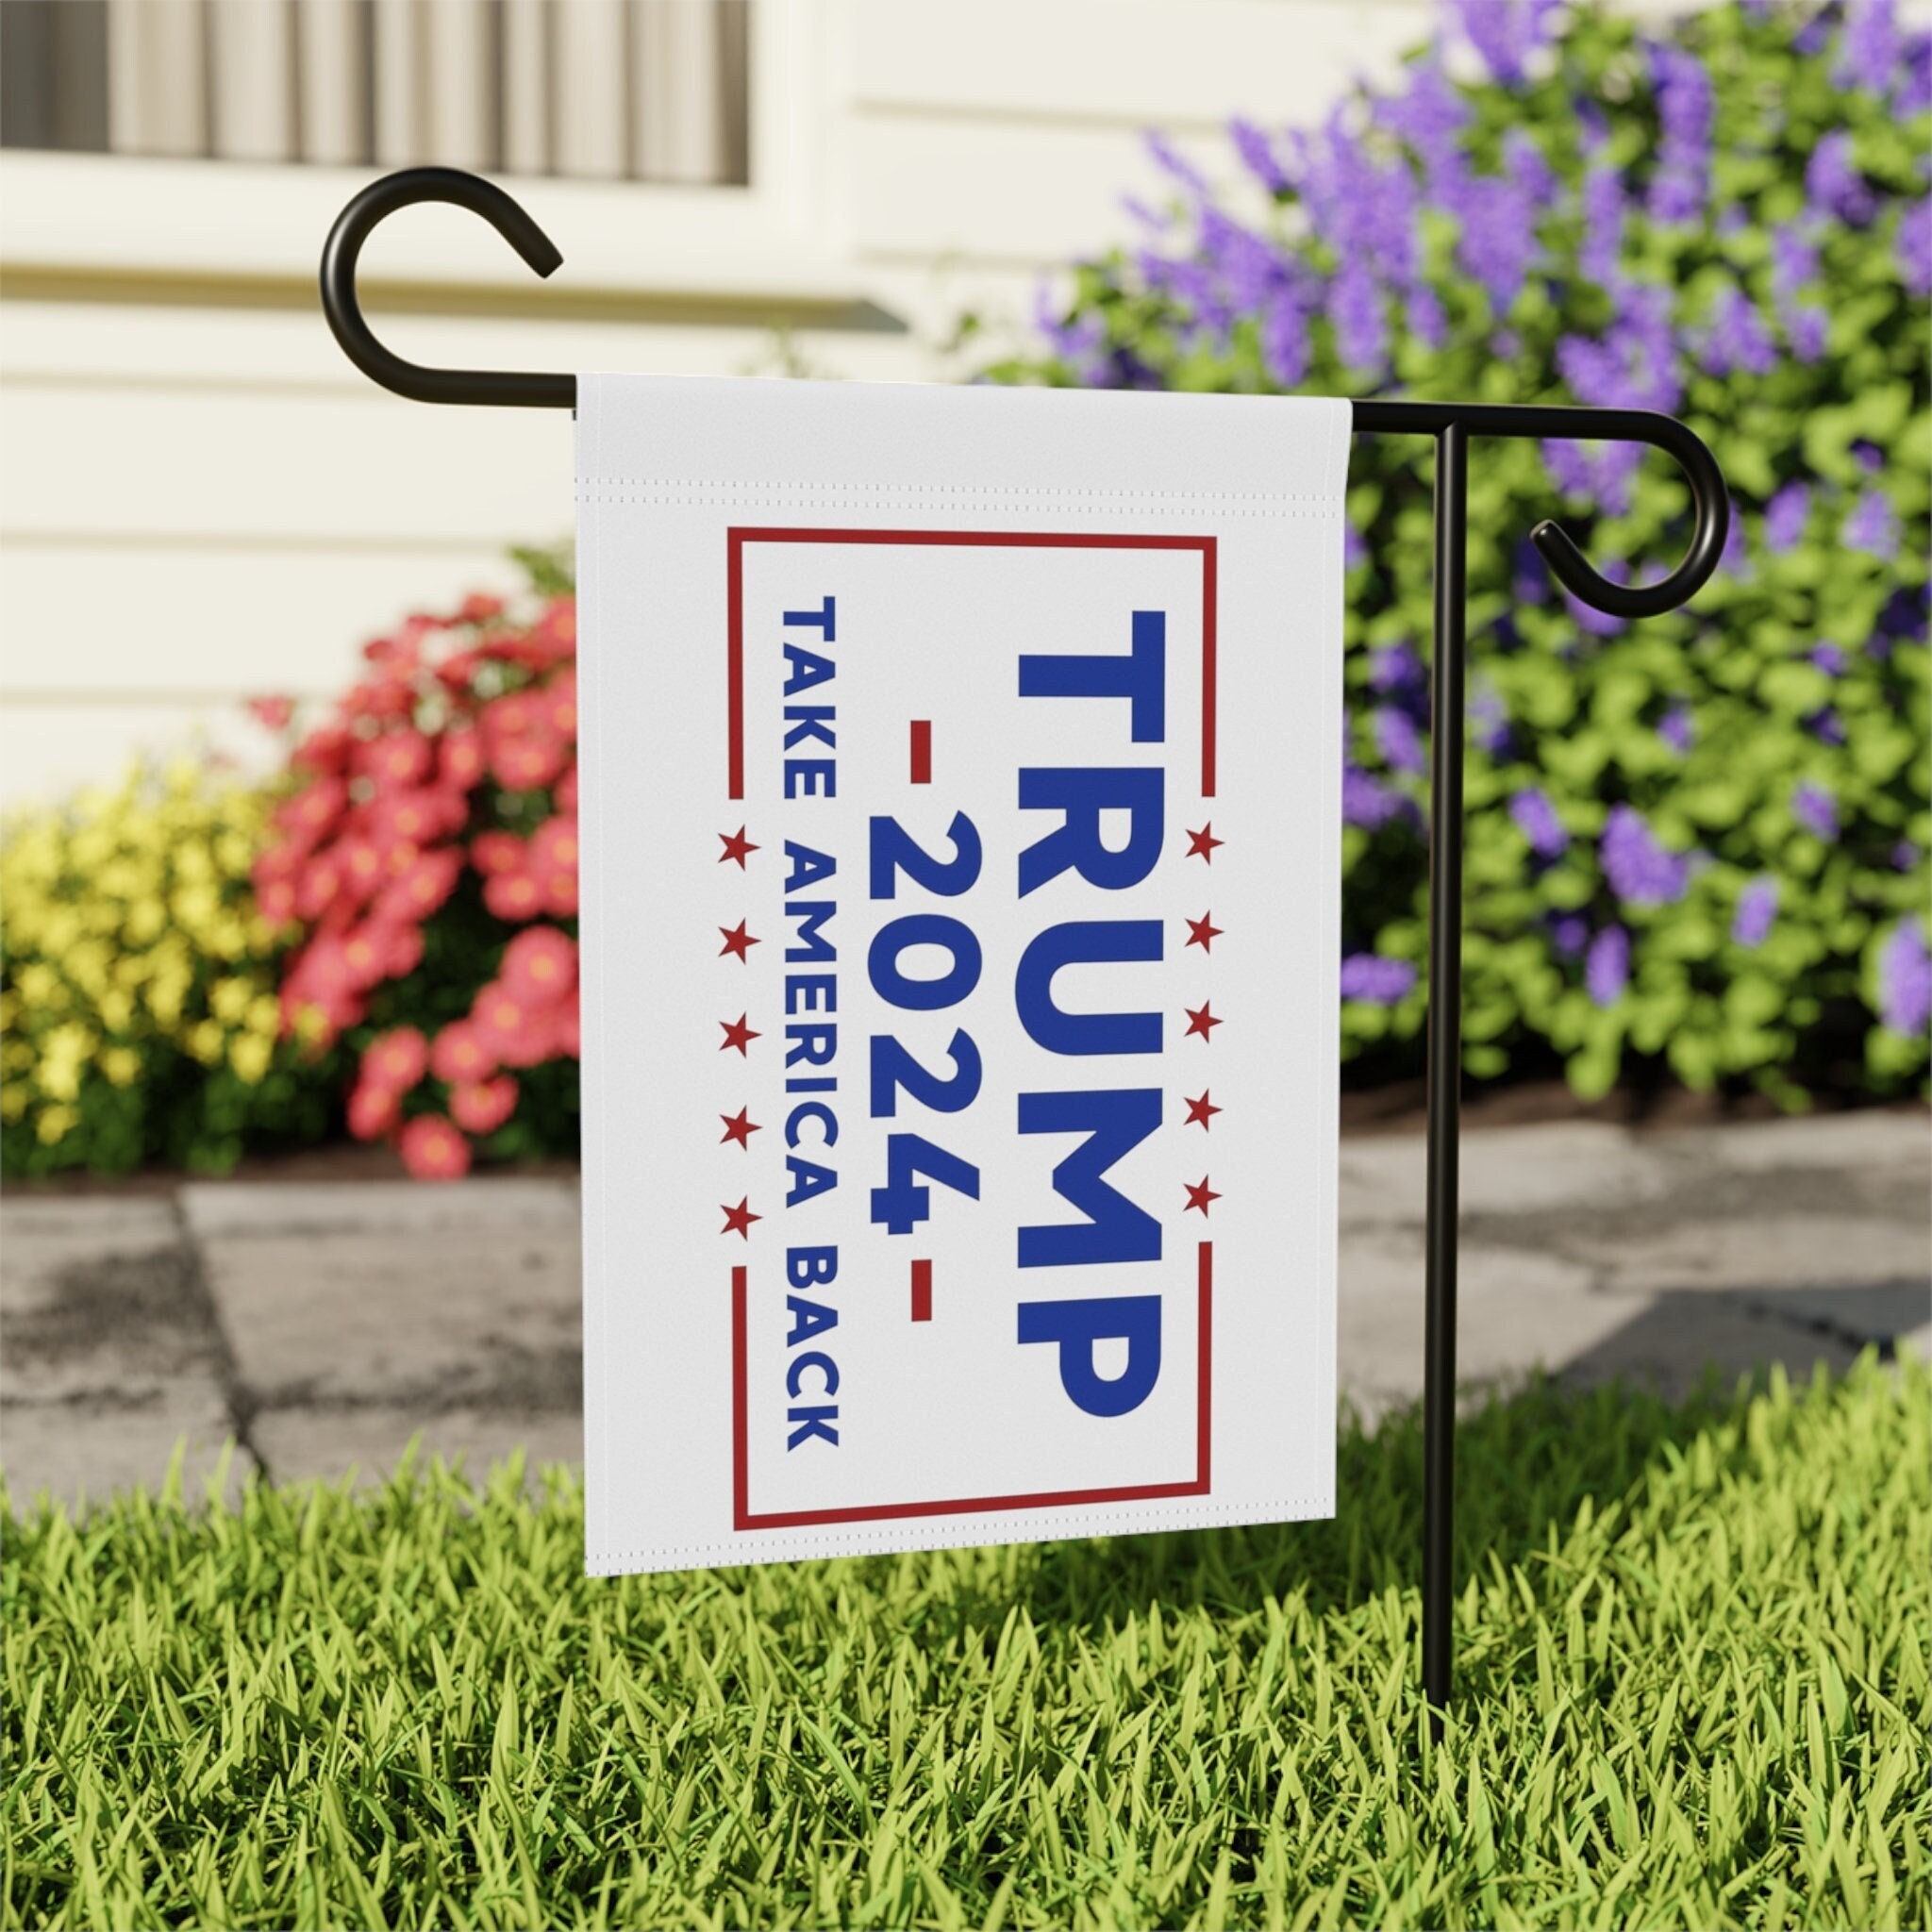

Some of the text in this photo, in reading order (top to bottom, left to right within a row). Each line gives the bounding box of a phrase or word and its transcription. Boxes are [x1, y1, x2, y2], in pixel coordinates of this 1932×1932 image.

[782, 595, 840, 1452] TAKE AMERICA BACK
[1014, 610, 1166, 1418] TRUMP
